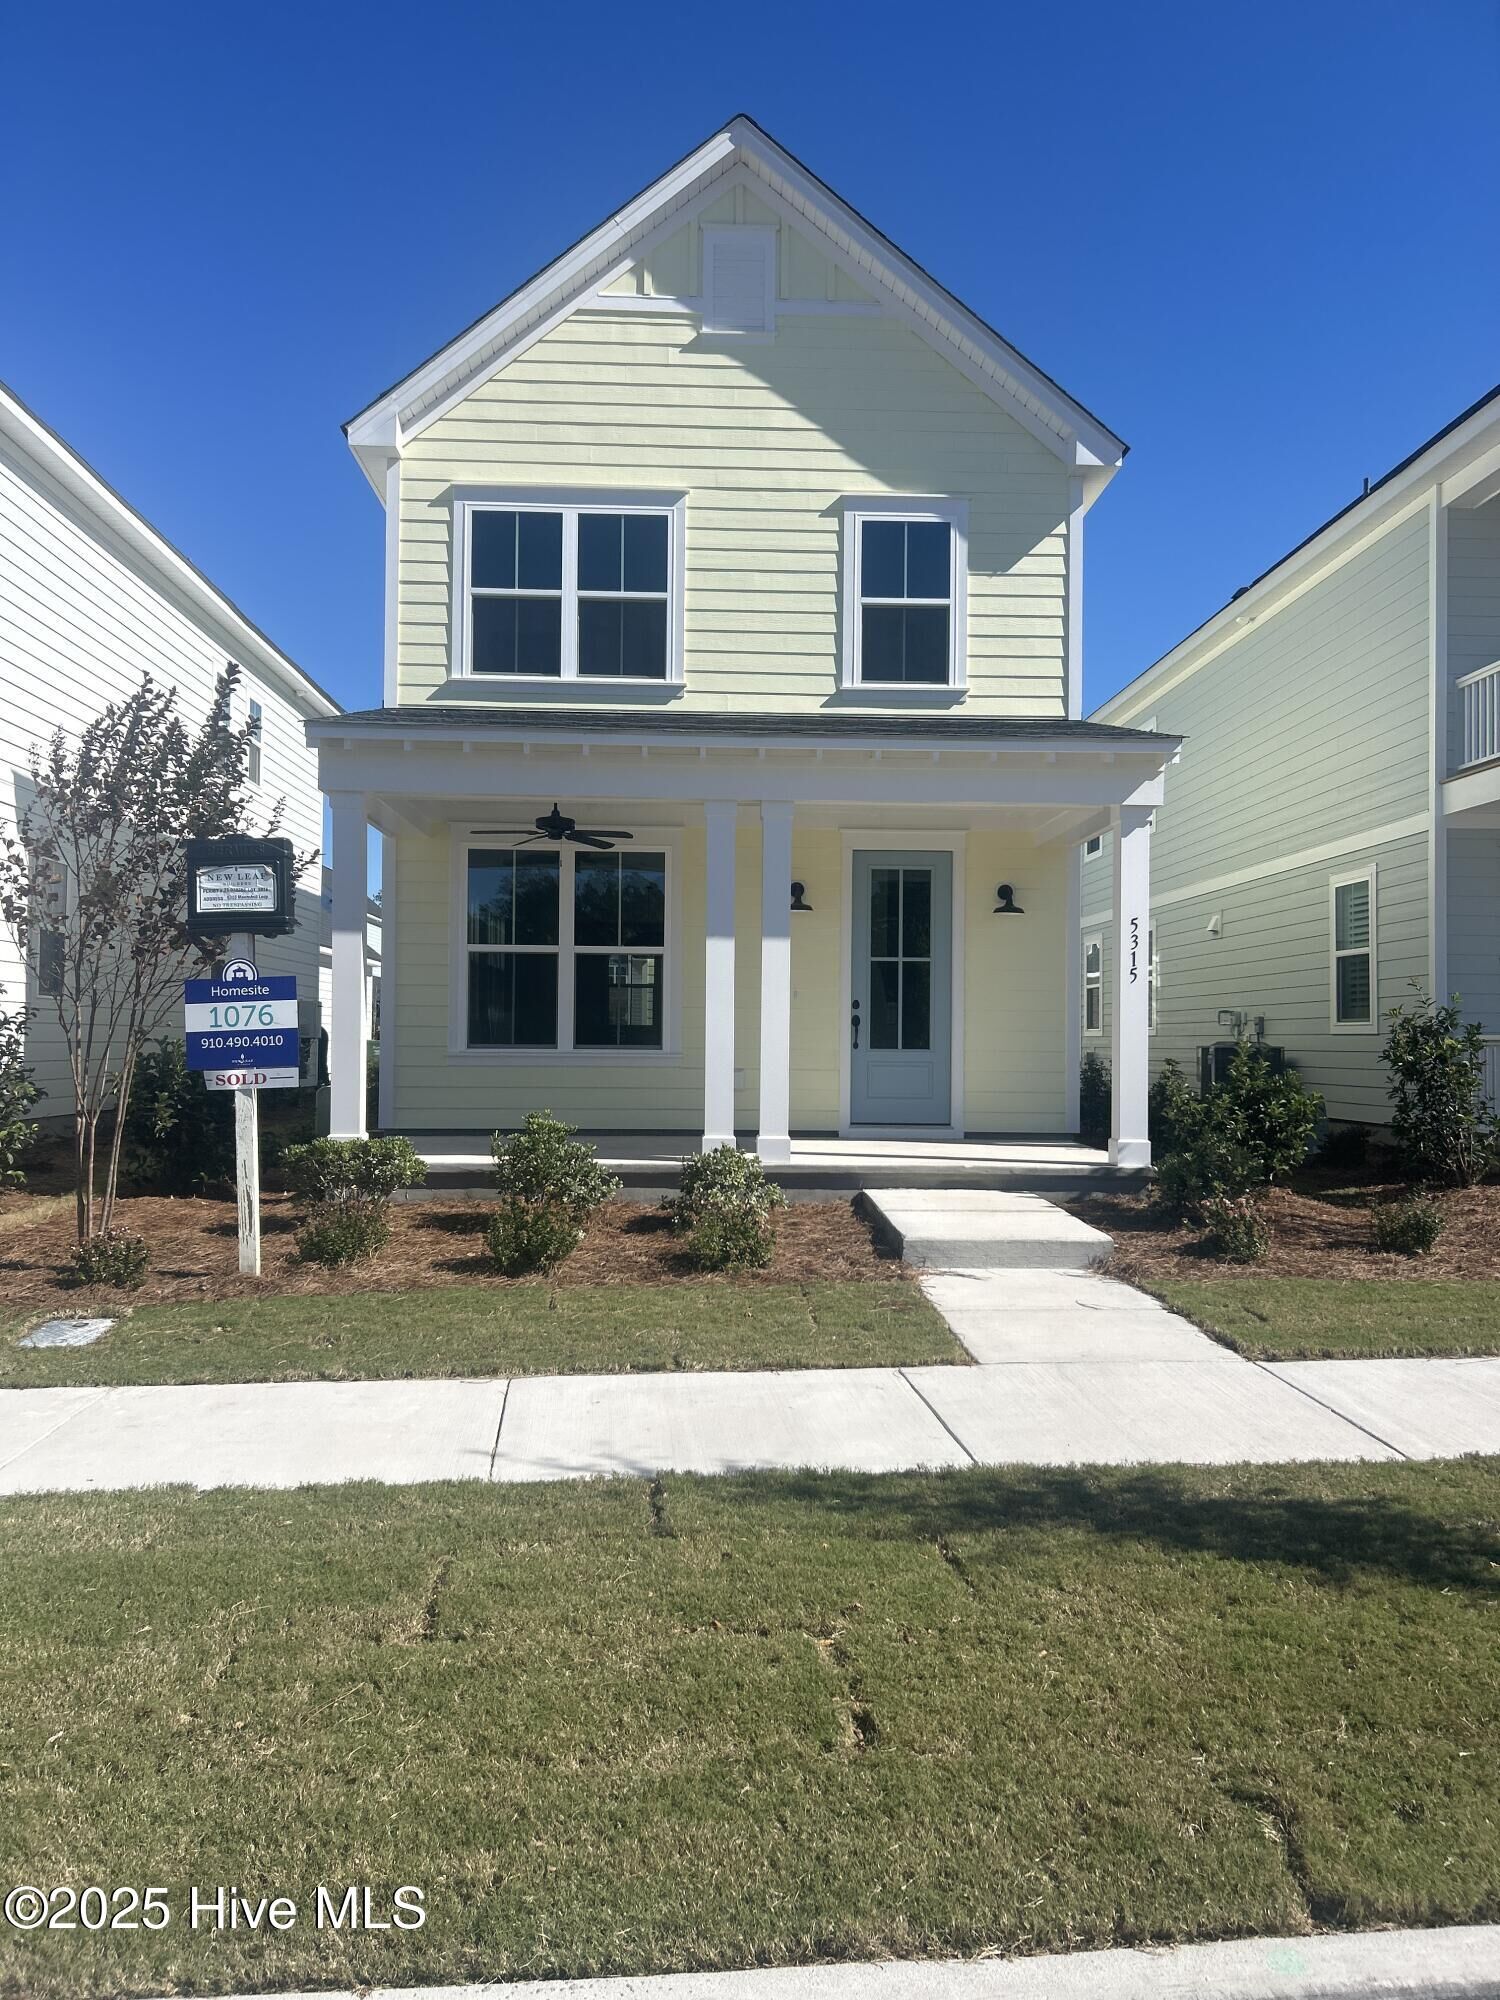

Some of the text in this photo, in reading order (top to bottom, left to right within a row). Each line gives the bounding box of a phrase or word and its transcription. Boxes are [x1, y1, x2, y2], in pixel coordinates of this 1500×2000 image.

[207, 872, 266, 882] NEW LEAF
[1129, 917, 1139, 985] 5315
[211, 985, 270, 997] Homesite
[209, 1004, 274, 1028] 1076
[201, 1035, 283, 1049] 910.490.4010
[215, 1072, 267, 1086] SOLD
